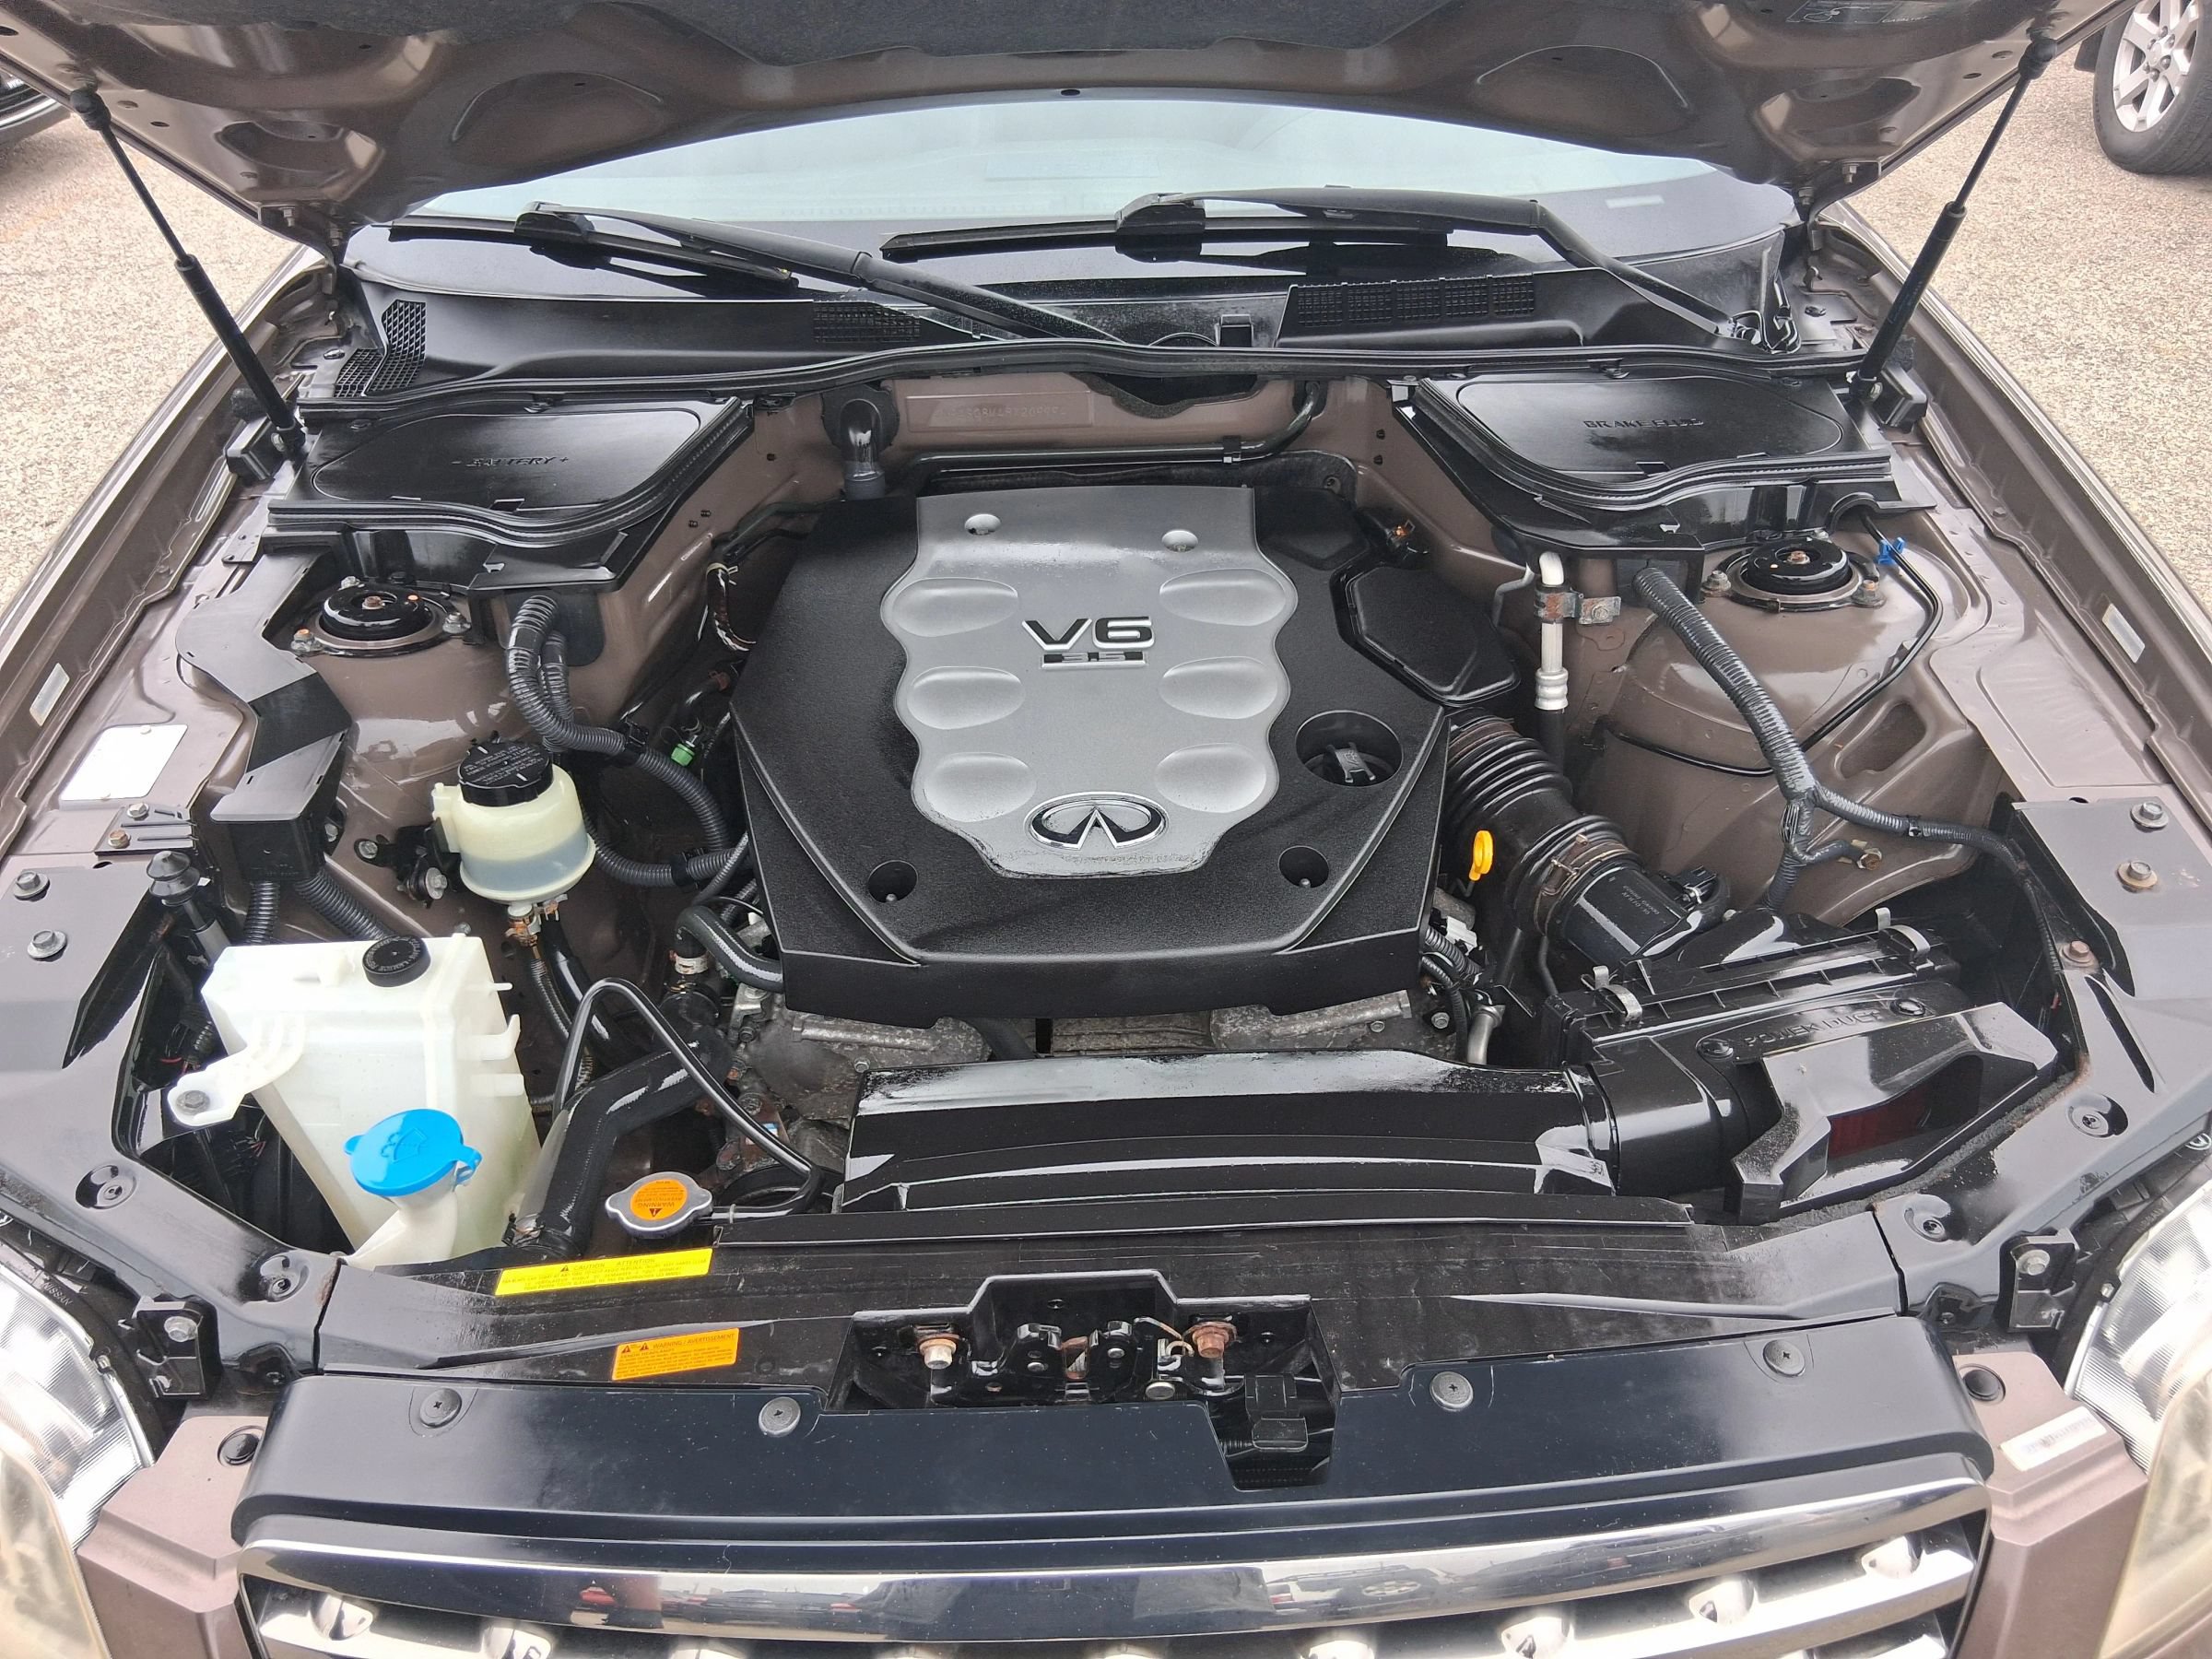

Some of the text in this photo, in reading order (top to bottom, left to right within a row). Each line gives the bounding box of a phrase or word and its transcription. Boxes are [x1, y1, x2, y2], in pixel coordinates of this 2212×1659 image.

[1583, 419, 1652, 428] BRAKE
[1021, 616, 1155, 651] V6
[573, 1263, 606, 1271] CAUTION
[653, 1341, 682, 1349] WARNING
